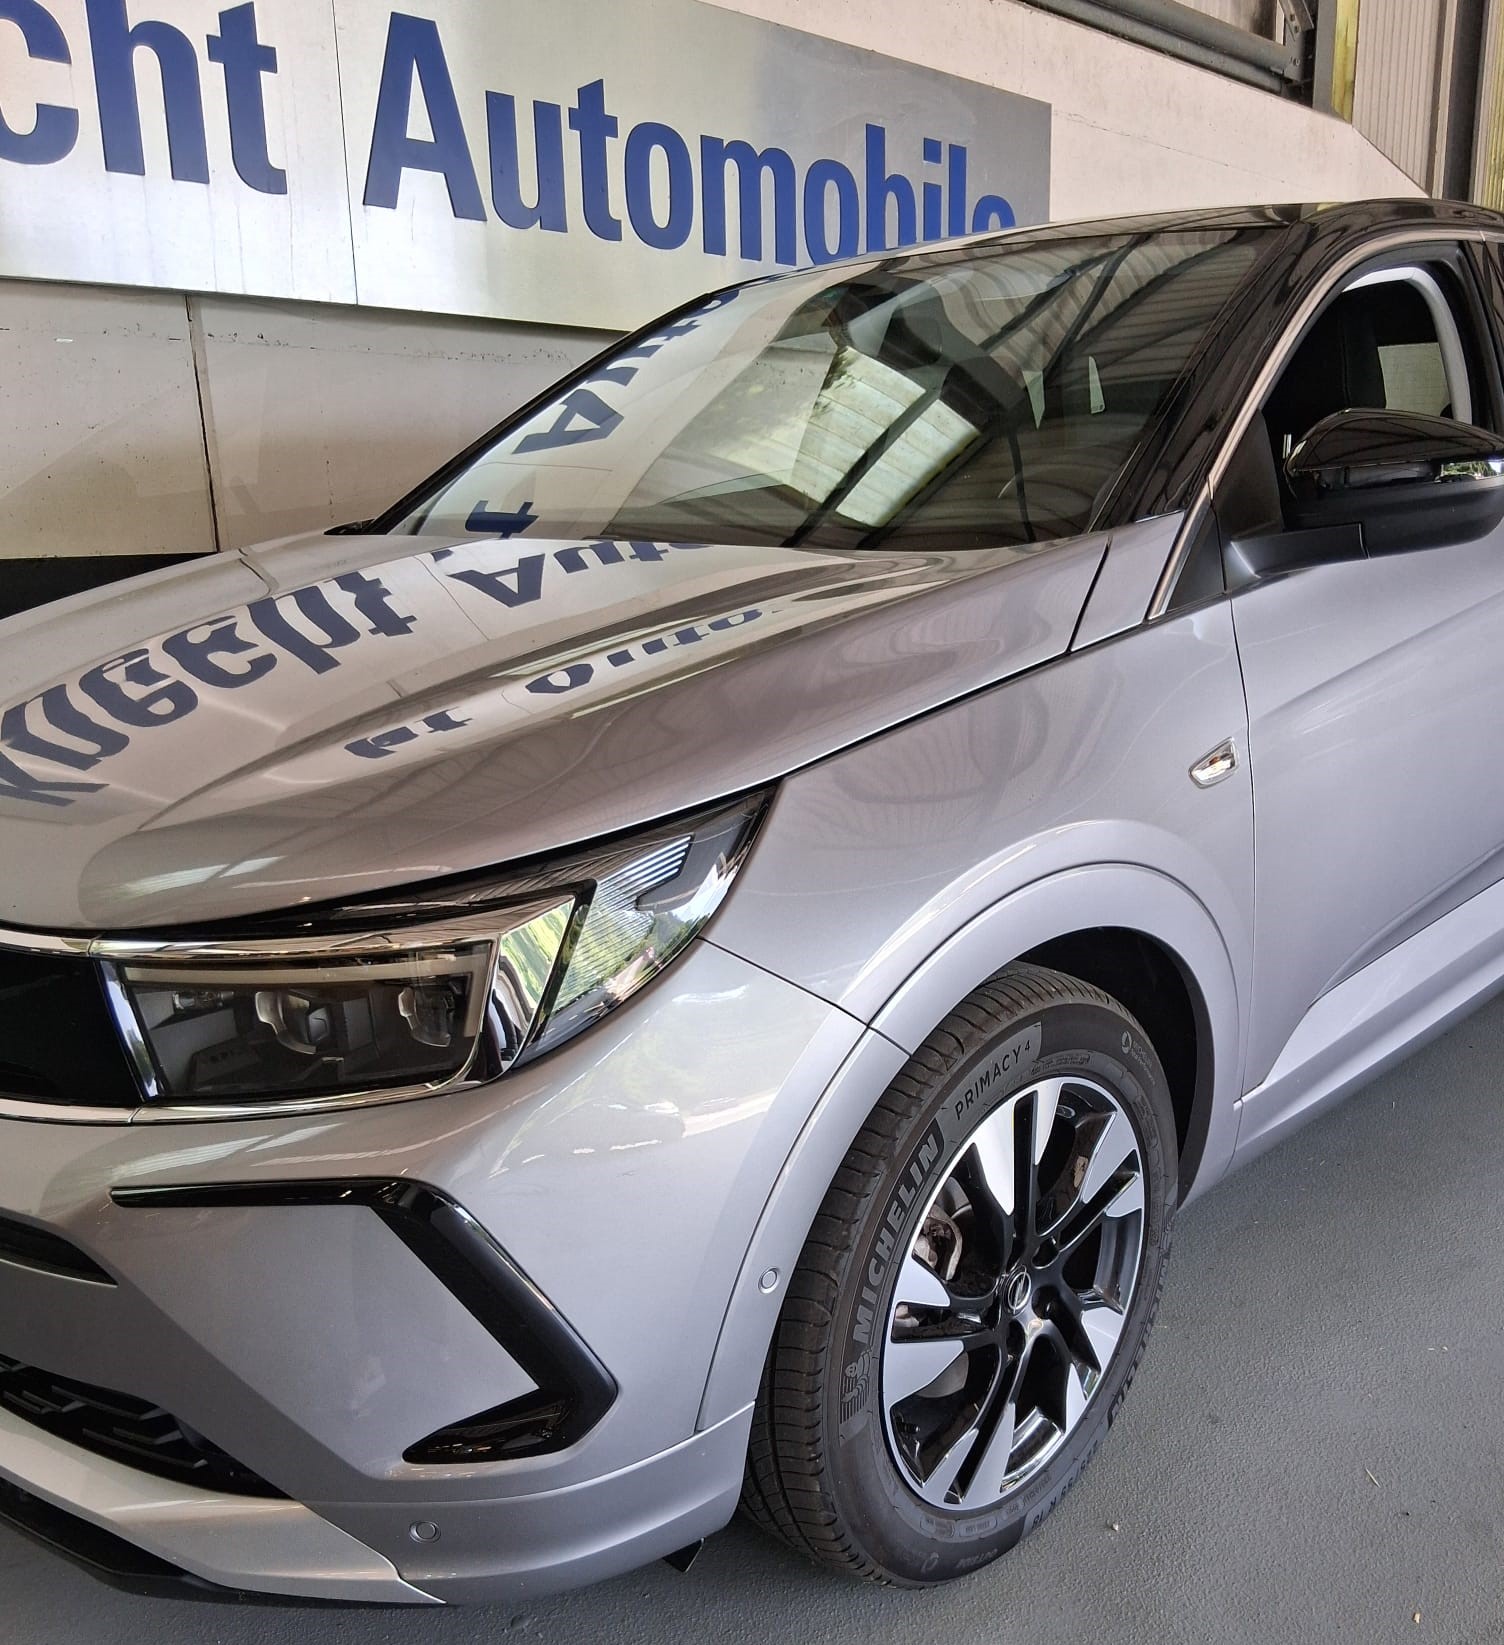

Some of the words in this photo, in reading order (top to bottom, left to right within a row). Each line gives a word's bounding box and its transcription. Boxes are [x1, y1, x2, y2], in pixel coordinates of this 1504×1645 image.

[853, 1133, 939, 1344] MICHELIN
[954, 1044, 1022, 1120] PRIMACY
[1024, 1039, 1031, 1052] 4
